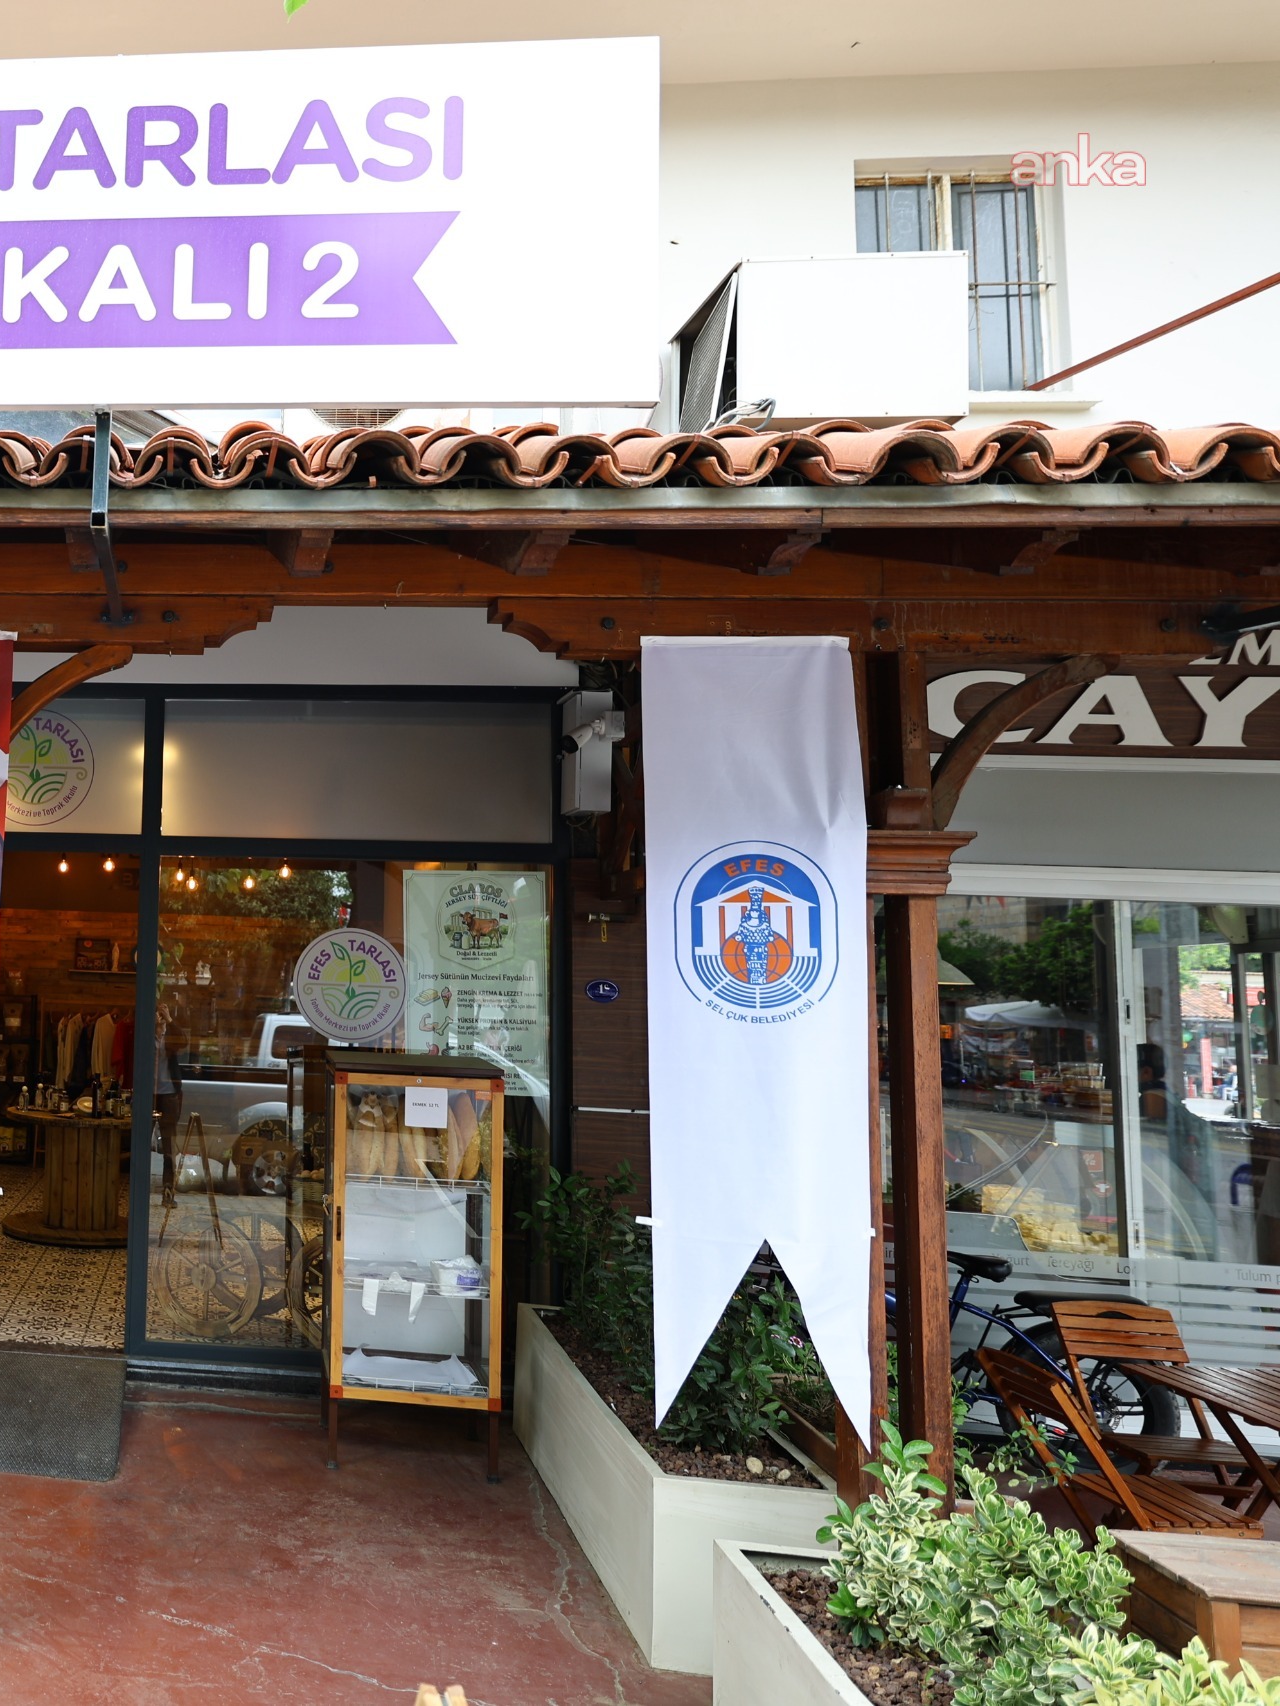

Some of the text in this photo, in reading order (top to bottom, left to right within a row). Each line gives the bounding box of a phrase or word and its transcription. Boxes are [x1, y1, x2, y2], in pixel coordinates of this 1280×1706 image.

[300, 241, 360, 318] 2
[33, 717, 85, 763] TARLASI
[7, 800, 32, 818] Merkezi
[42, 801, 66, 816] Toprak
[63, 785, 78, 803] Okulu
[723, 859, 785, 877] EFES
[308, 939, 397, 983] EFES TARLASI
[418, 973, 534, 983] Jersey Sütünün Mucizevi Faydaları
[310, 997, 325, 1018] Tohum
[322, 1015, 349, 1032] Merkezi
[358, 1017, 379, 1032] Toprak
[376, 1003, 391, 1020] Okulu
[705, 998, 815, 1024] SELÇUK BELEDİYESİ
[991, 1253, 1029, 1267] Yğurt
[1235, 1268, 1272, 1283] Tulum
